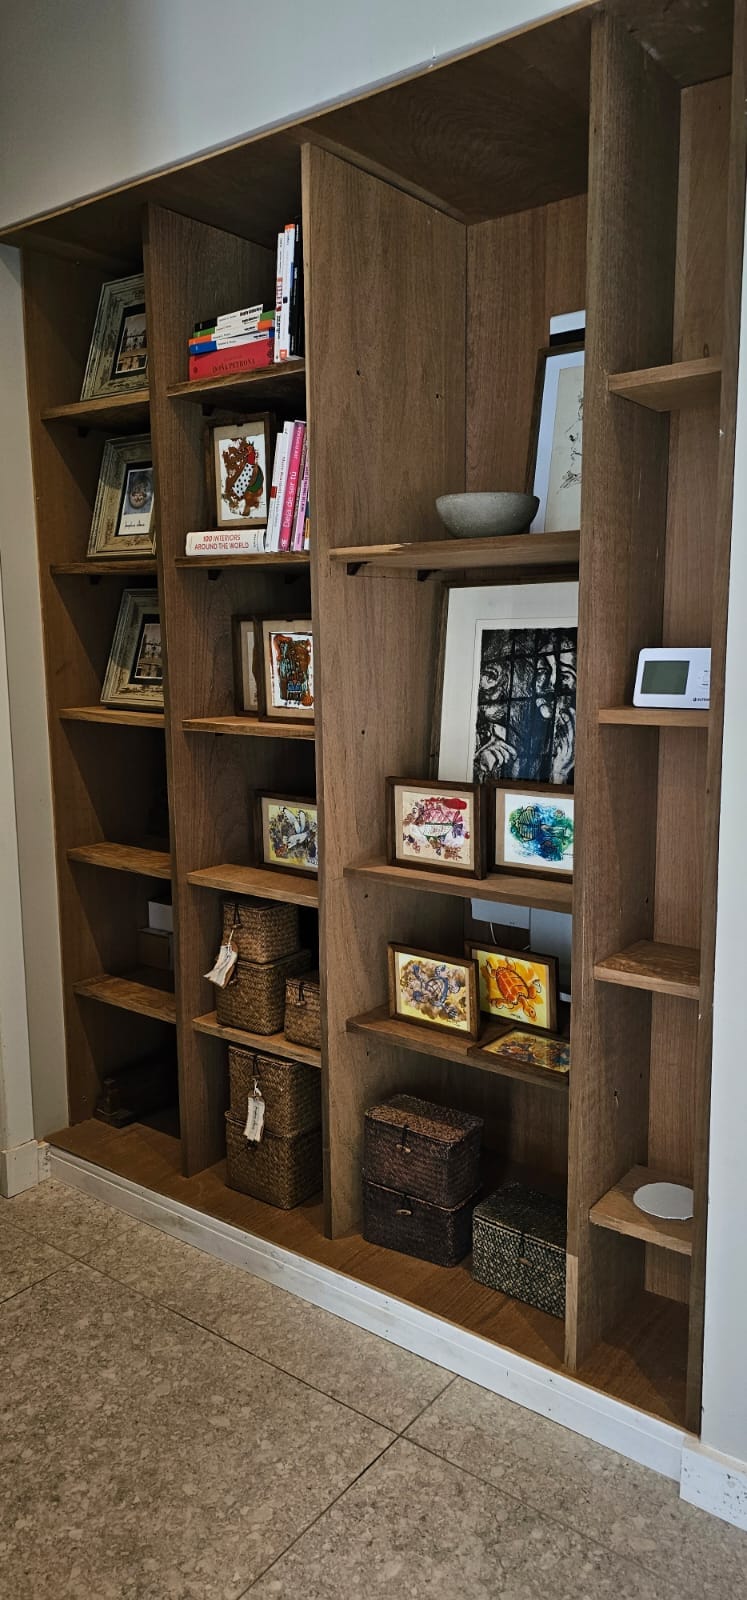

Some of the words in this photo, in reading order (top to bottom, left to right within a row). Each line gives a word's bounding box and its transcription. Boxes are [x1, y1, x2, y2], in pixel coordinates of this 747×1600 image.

[229, 358, 256, 369] PETRONA
[290, 471, 296, 480] tú
[286, 496, 293, 507] de
[283, 508, 292, 528] Deja
